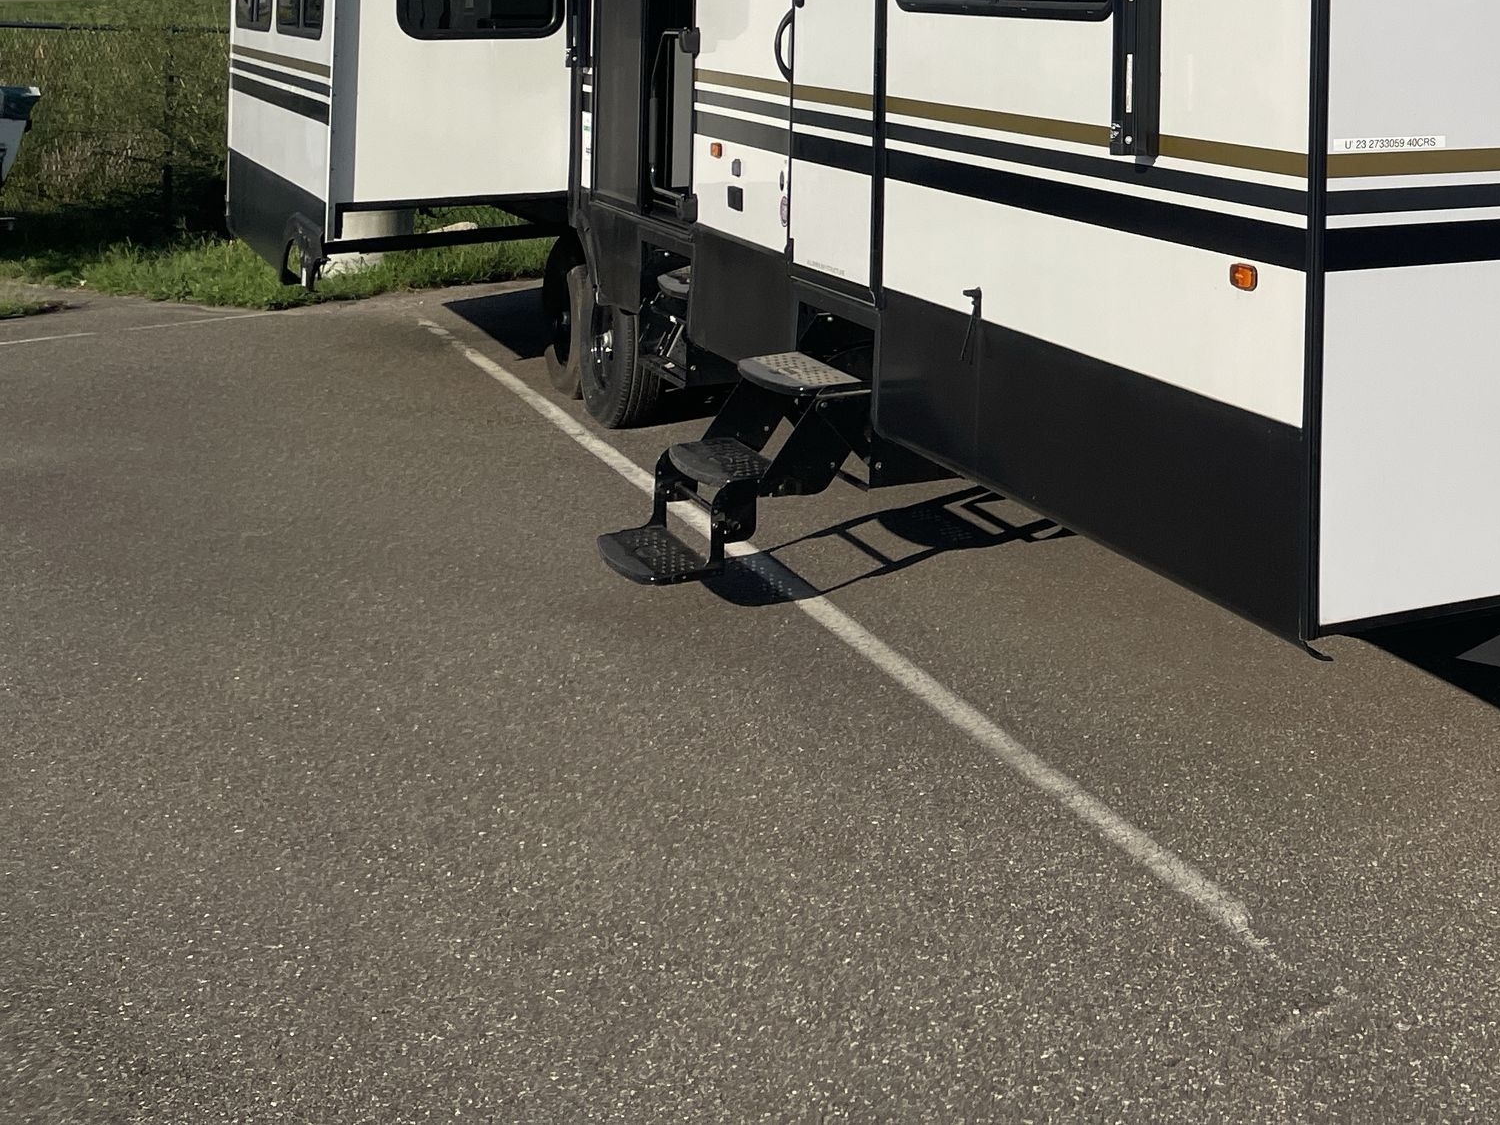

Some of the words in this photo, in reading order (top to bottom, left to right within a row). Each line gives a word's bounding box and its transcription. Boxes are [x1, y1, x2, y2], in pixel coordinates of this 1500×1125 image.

[1355, 139, 1367, 149] 23
[1368, 138, 1405, 149] 2733059
[1407, 137, 1436, 148] 40CRS
